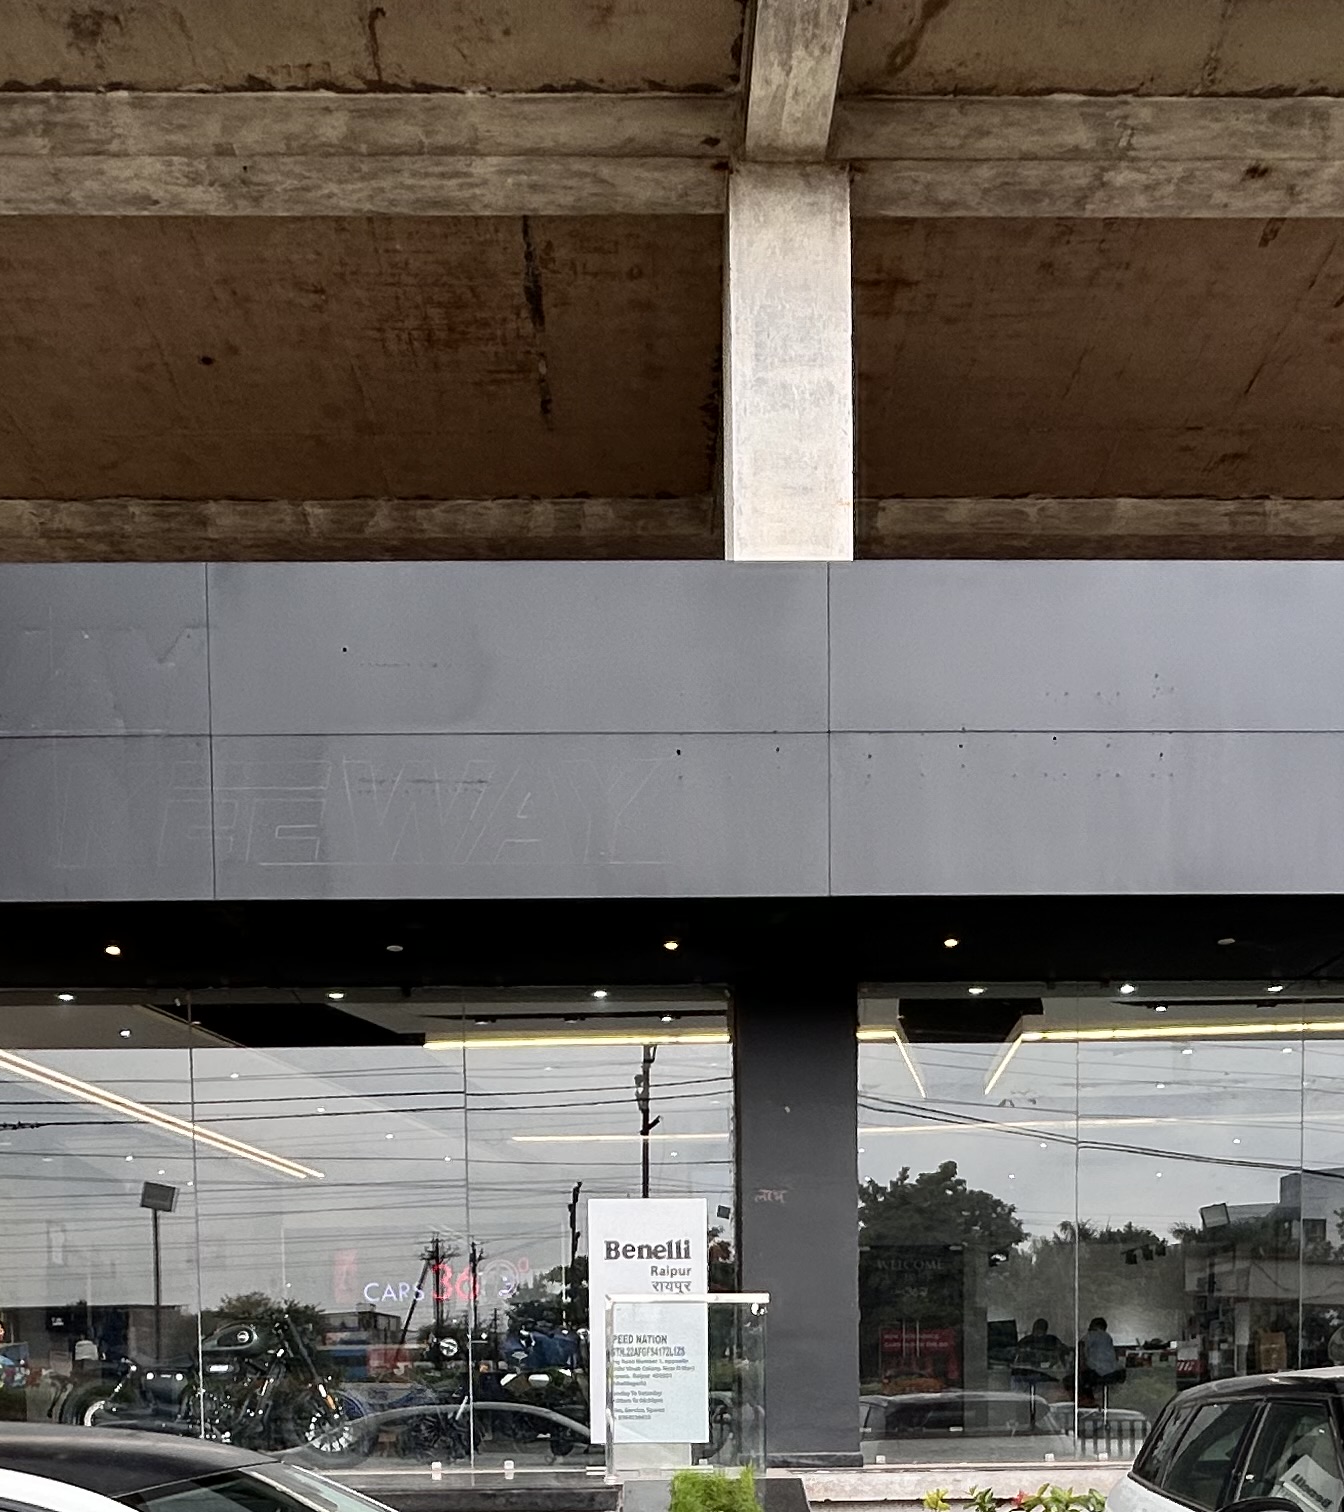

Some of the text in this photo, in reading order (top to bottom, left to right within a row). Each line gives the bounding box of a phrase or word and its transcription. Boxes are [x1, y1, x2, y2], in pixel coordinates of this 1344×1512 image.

[604, 1239, 692, 1260] Benelli
[650, 1265, 692, 1278] Raipur
[612, 1334, 668, 1345] PEED NATION
